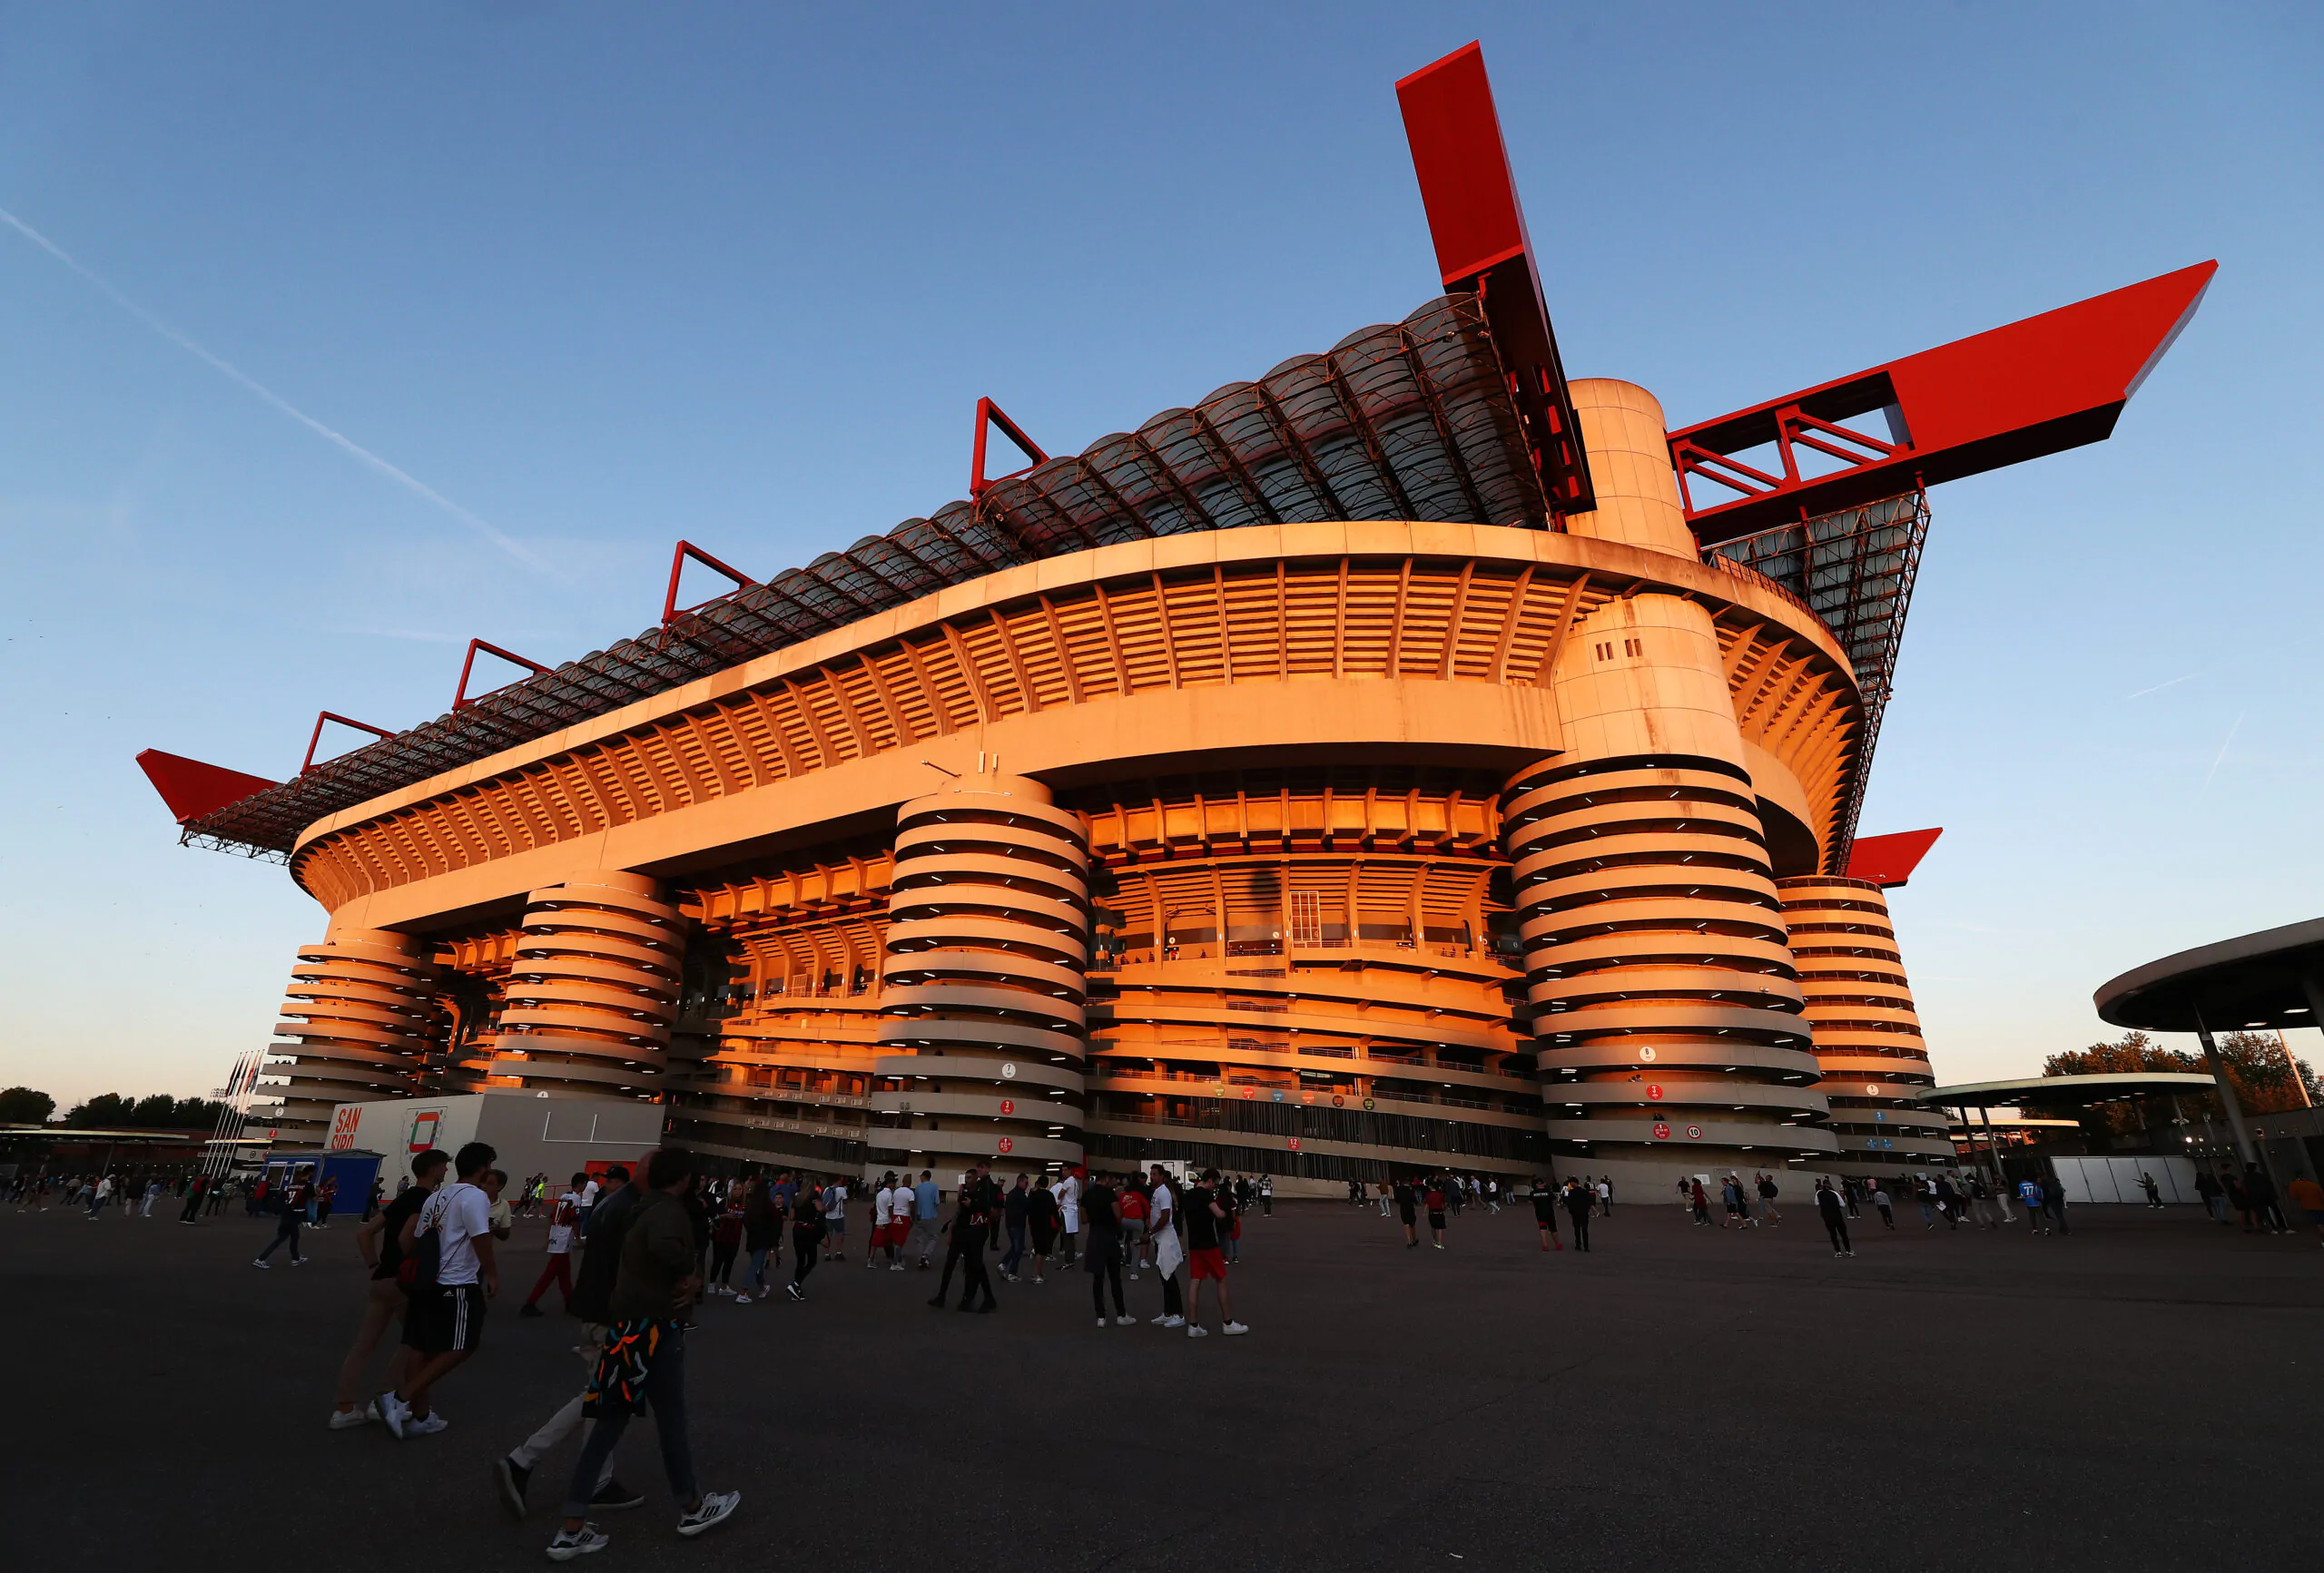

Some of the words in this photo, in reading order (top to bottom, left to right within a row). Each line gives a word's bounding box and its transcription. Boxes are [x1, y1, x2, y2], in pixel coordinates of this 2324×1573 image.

[336, 1107, 362, 1133] SAN
[1690, 1128, 1699, 1136] 10
[2024, 1185, 2034, 1195] 77
